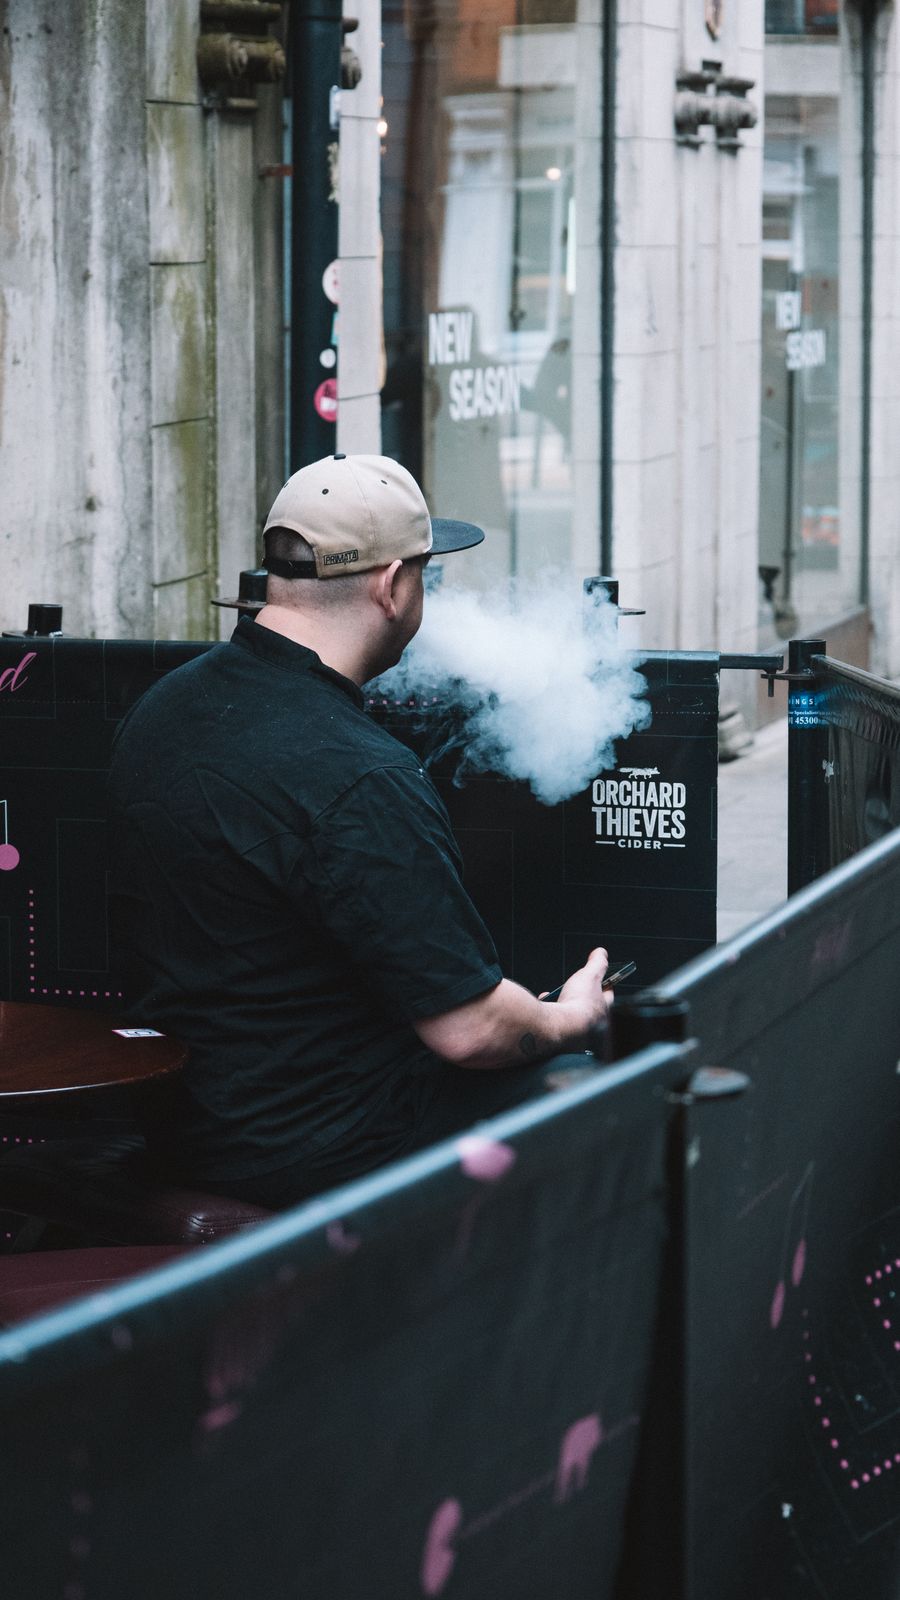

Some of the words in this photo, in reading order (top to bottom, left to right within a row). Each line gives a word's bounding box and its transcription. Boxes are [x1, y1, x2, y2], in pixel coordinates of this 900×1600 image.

[429, 312, 473, 365] NEW
[450, 366, 520, 421] SEASON
[592, 779, 686, 808] ORCHARD
[592, 807, 686, 839] THIEVES
[618, 839, 662, 849] CIDER
